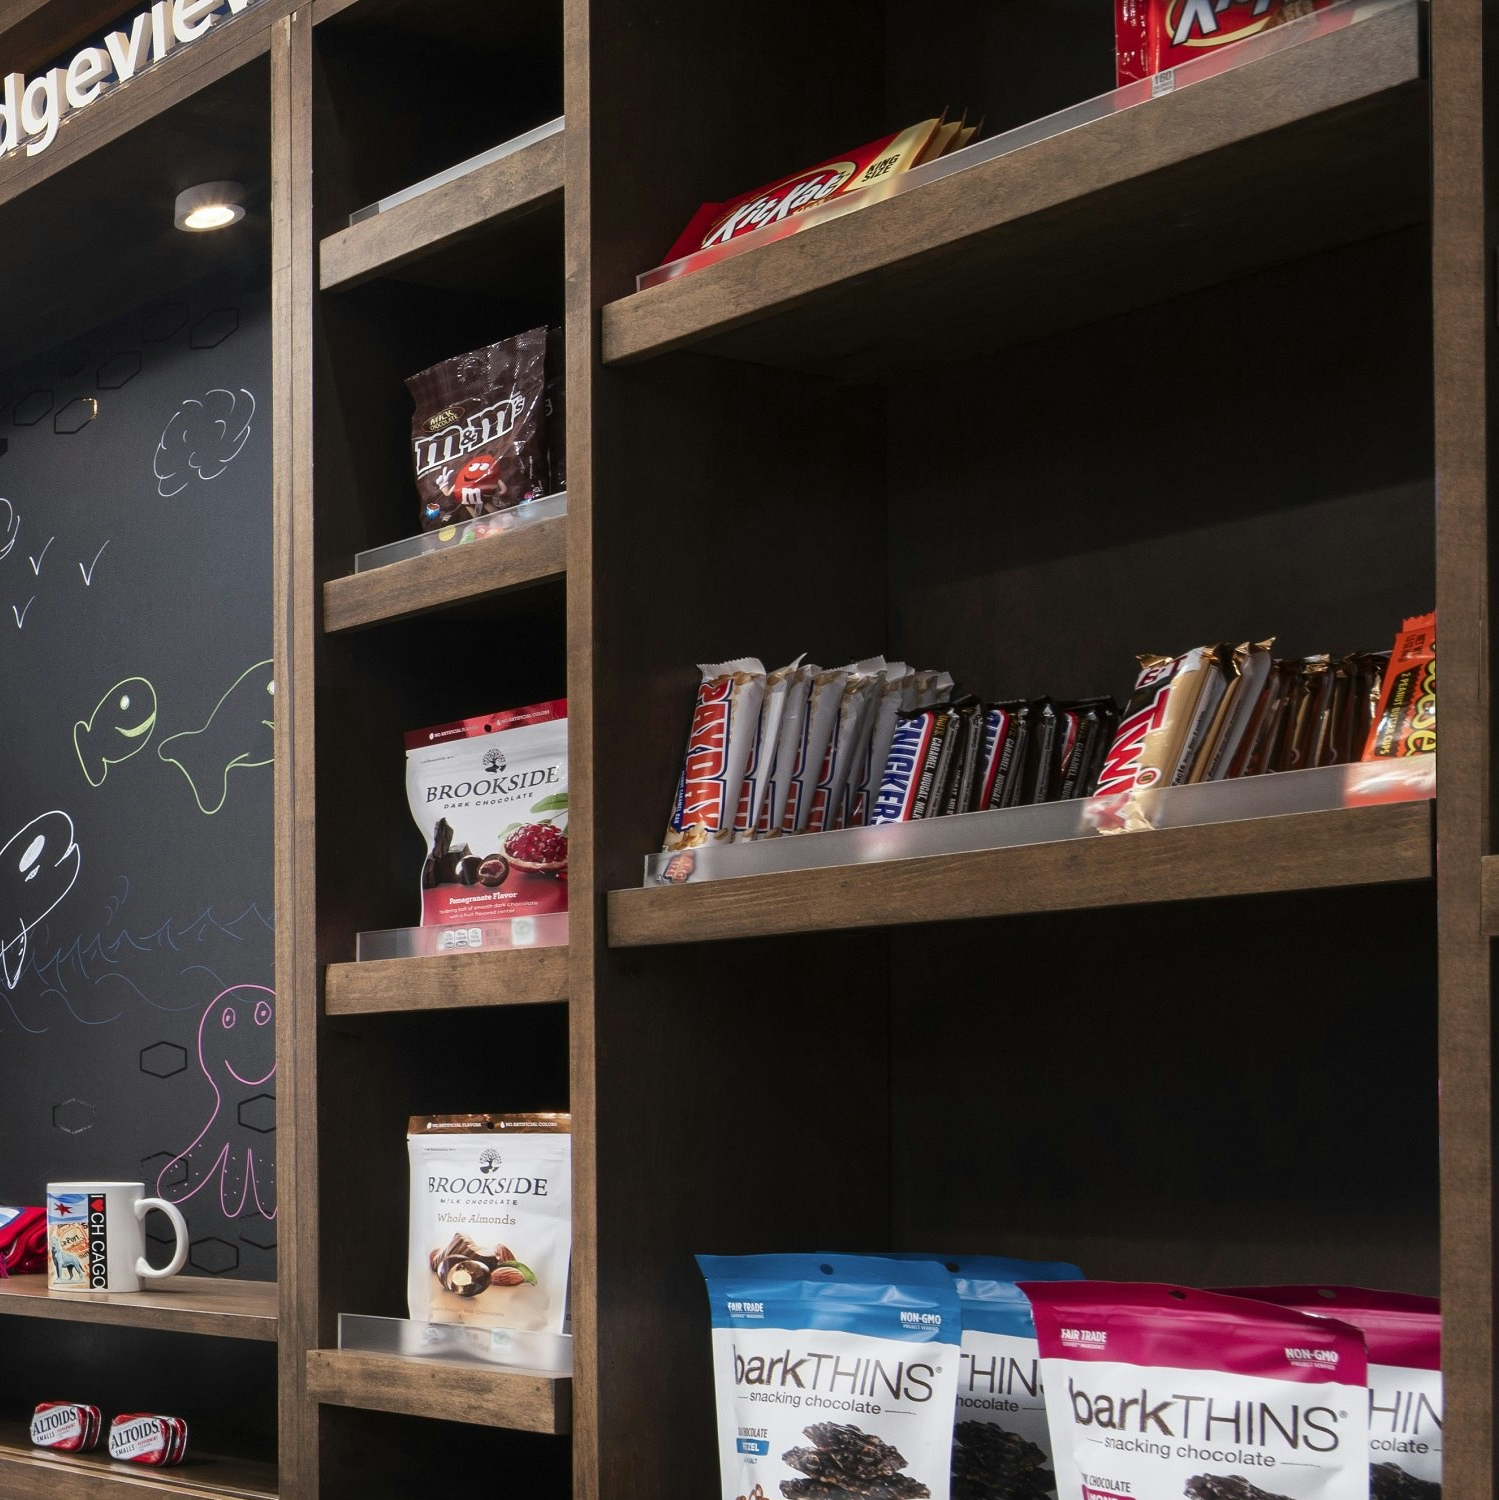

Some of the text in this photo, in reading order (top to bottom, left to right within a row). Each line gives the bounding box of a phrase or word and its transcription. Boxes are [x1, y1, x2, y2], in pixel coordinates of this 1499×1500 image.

[861, 163, 892, 182] SIZE
[865, 153, 901, 174] KING
[680, 678, 734, 832] PAYDAY
[870, 711, 928, 826] SNICKER
[426, 766, 560, 803] BROOKSIDE
[444, 792, 534, 809] DARK CHOCOLATE
[449, 891, 518, 905] Pomegranate Flavor
[428, 1176, 548, 1197] BROOKSIDE
[437, 1213, 516, 1225] Whole Almonds
[727, 1301, 765, 1313] FAIR TRADE
[899, 1311, 942, 1326] NON-GMO
[1061, 1328, 1107, 1344] FAIR TRADE
[1284, 1346, 1340, 1364] NON-GMO
[732, 1343, 934, 1403] barkTHINS
[749, 1390, 882, 1416] snacking chocolate
[32, 1407, 77, 1436] ALTOIDS
[1068, 1376, 1340, 1454] barkTHINS
[36, 1431, 55, 1443] SMALLS
[110, 1419, 160, 1449] ALTOIDS
[115, 1445, 135, 1457] SMALLS
[1104, 1436, 1276, 1468] snacking chocolate
[1089, 1474, 1131, 1493] CHOCOLATE
